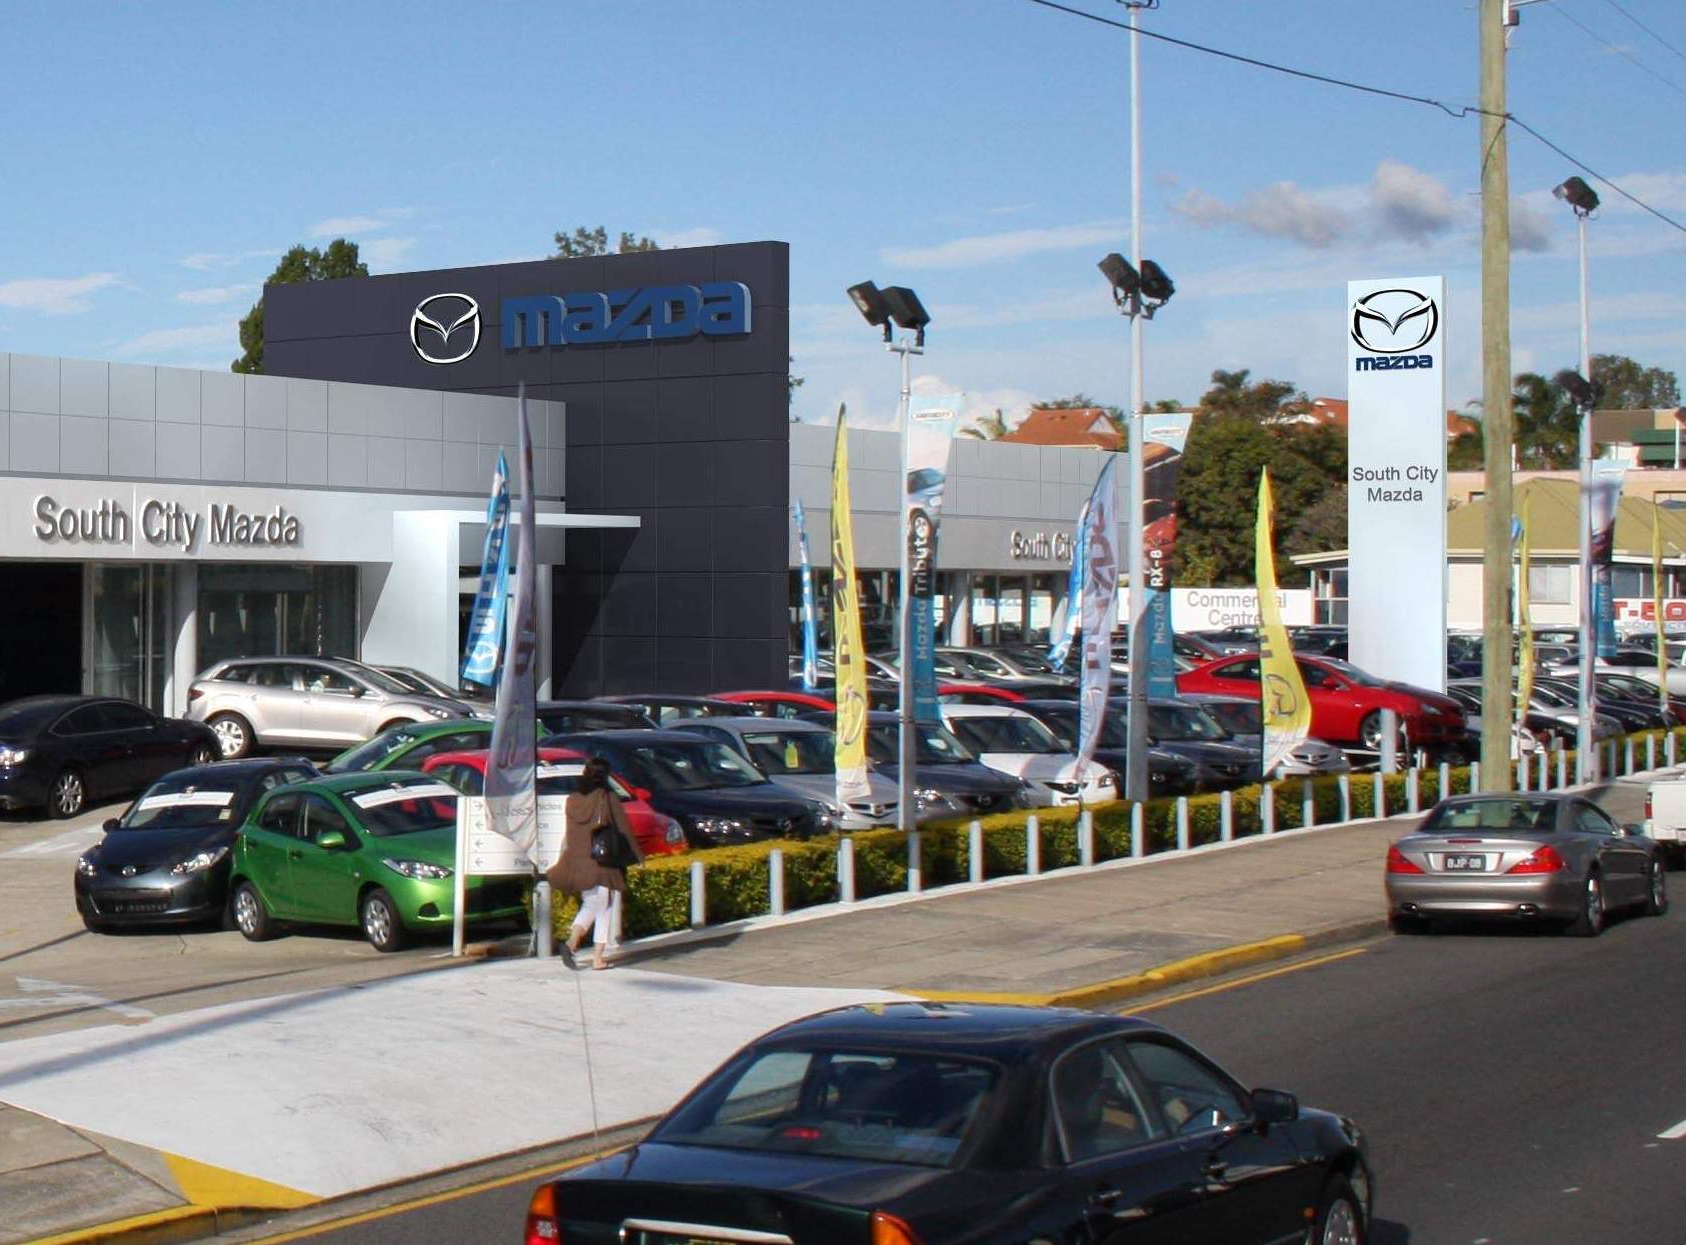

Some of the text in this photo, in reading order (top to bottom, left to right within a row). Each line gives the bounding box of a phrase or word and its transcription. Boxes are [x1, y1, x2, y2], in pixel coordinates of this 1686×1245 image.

[502, 281, 751, 349] mazda
[1356, 355, 1433, 371] mazda
[1352, 466, 1438, 483] South City
[1368, 488, 1422, 502] Mazda
[33, 496, 300, 552] South City Mazda
[1150, 549, 1163, 587] RX-8
[1187, 591, 1286, 608] Commeral
[1208, 609, 1262, 625] Centre
